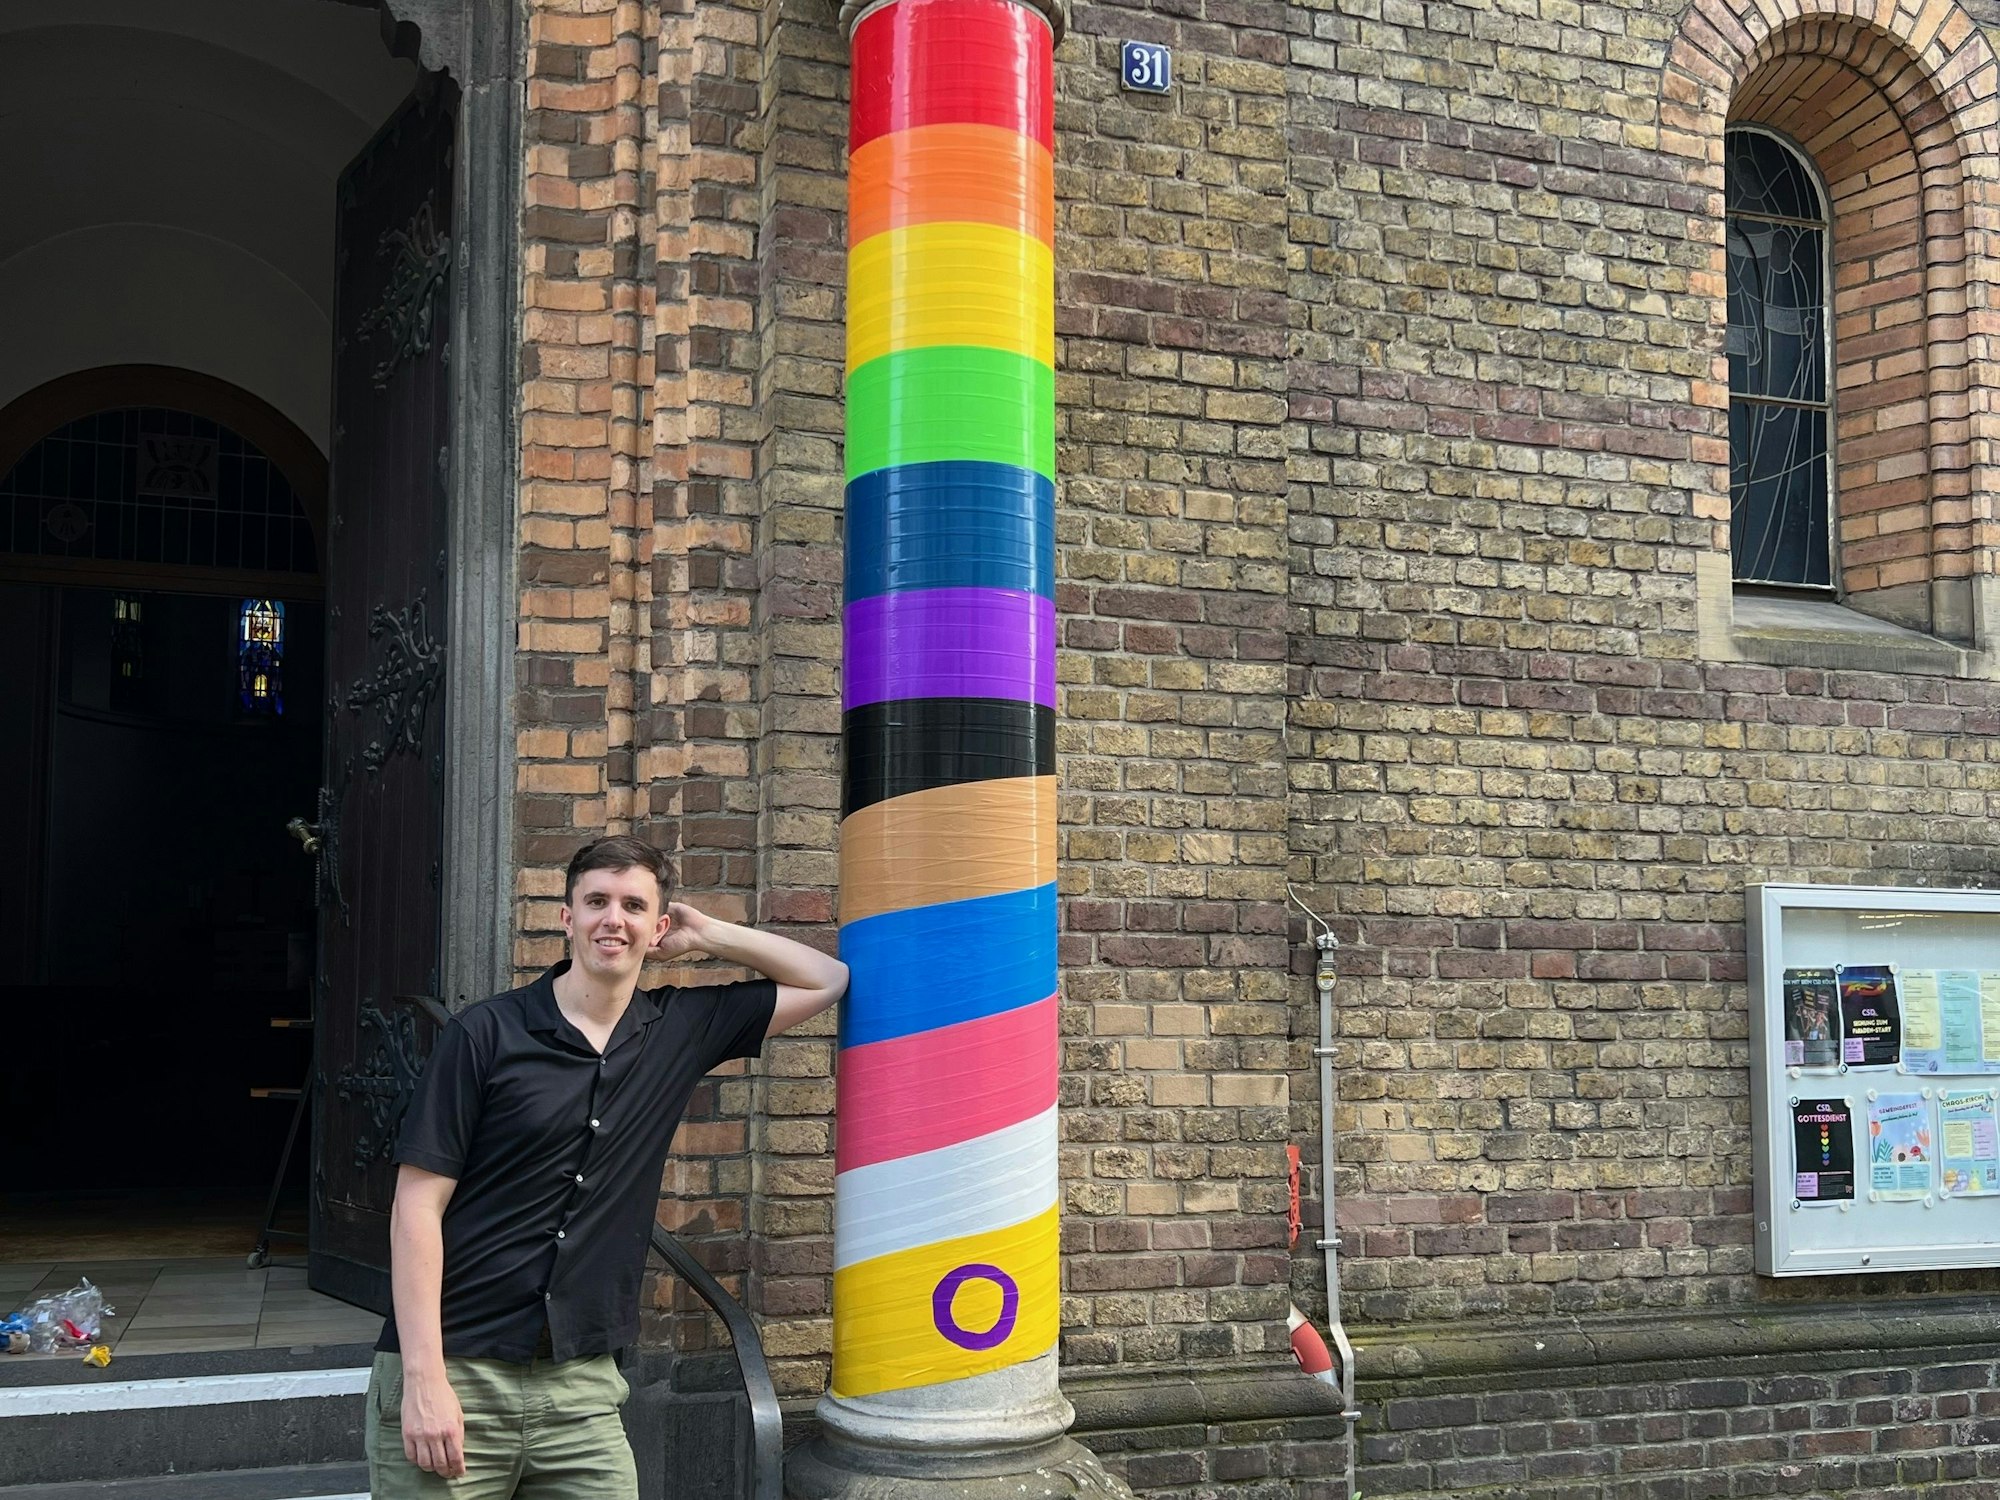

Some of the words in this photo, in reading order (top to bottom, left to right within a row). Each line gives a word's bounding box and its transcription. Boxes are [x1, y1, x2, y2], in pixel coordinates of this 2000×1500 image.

[1131, 47, 1164, 88] 31
[1941, 1094, 1985, 1108] CHAOS-KIRCHE
[1878, 1102, 1917, 1114] GEMEINDEFEST
[1797, 1113, 1847, 1123] GOTTESDIENST
